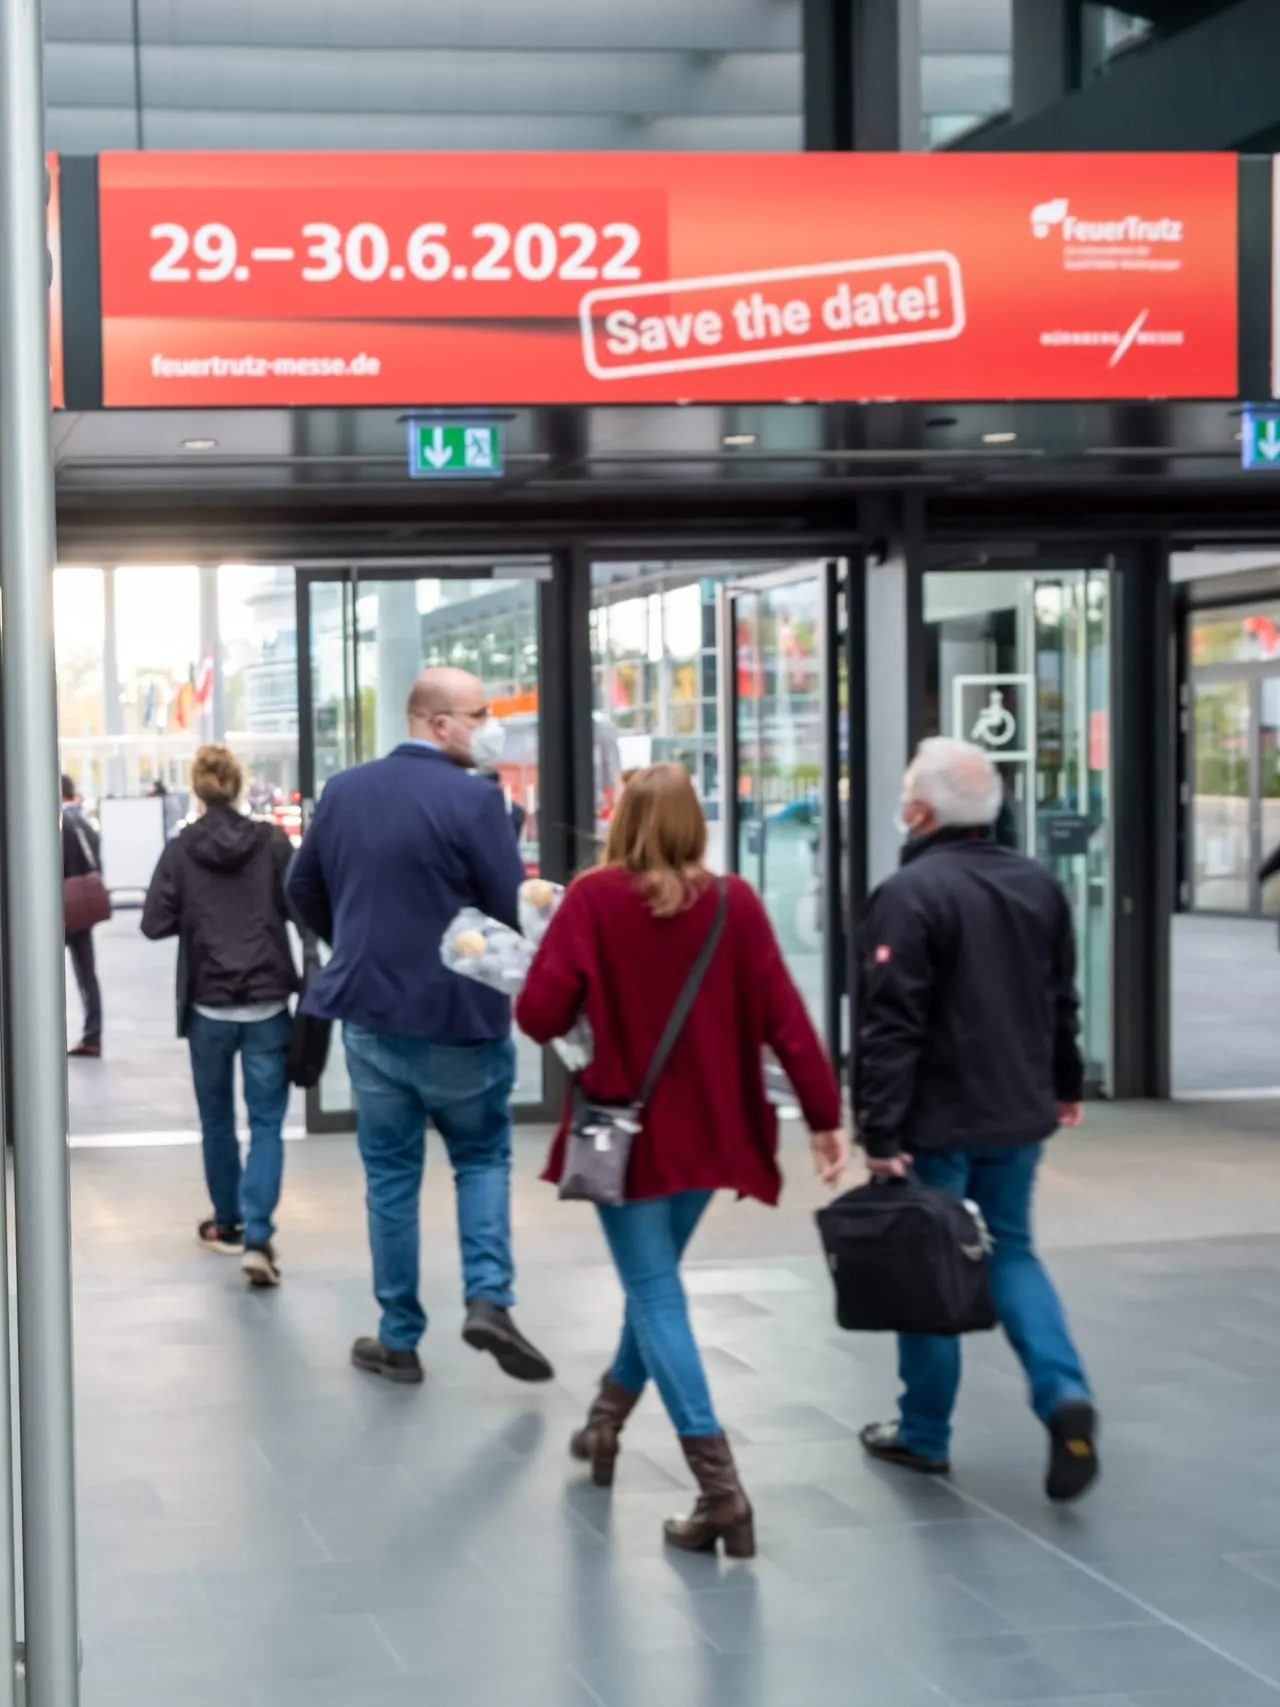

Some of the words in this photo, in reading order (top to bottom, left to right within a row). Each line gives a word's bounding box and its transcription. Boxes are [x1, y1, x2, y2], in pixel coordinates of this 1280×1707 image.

[605, 308, 723, 356] Save
[733, 292, 811, 341] the
[822, 274, 941, 331] date!
[151, 352, 381, 377] feuertrutz-messe.de
